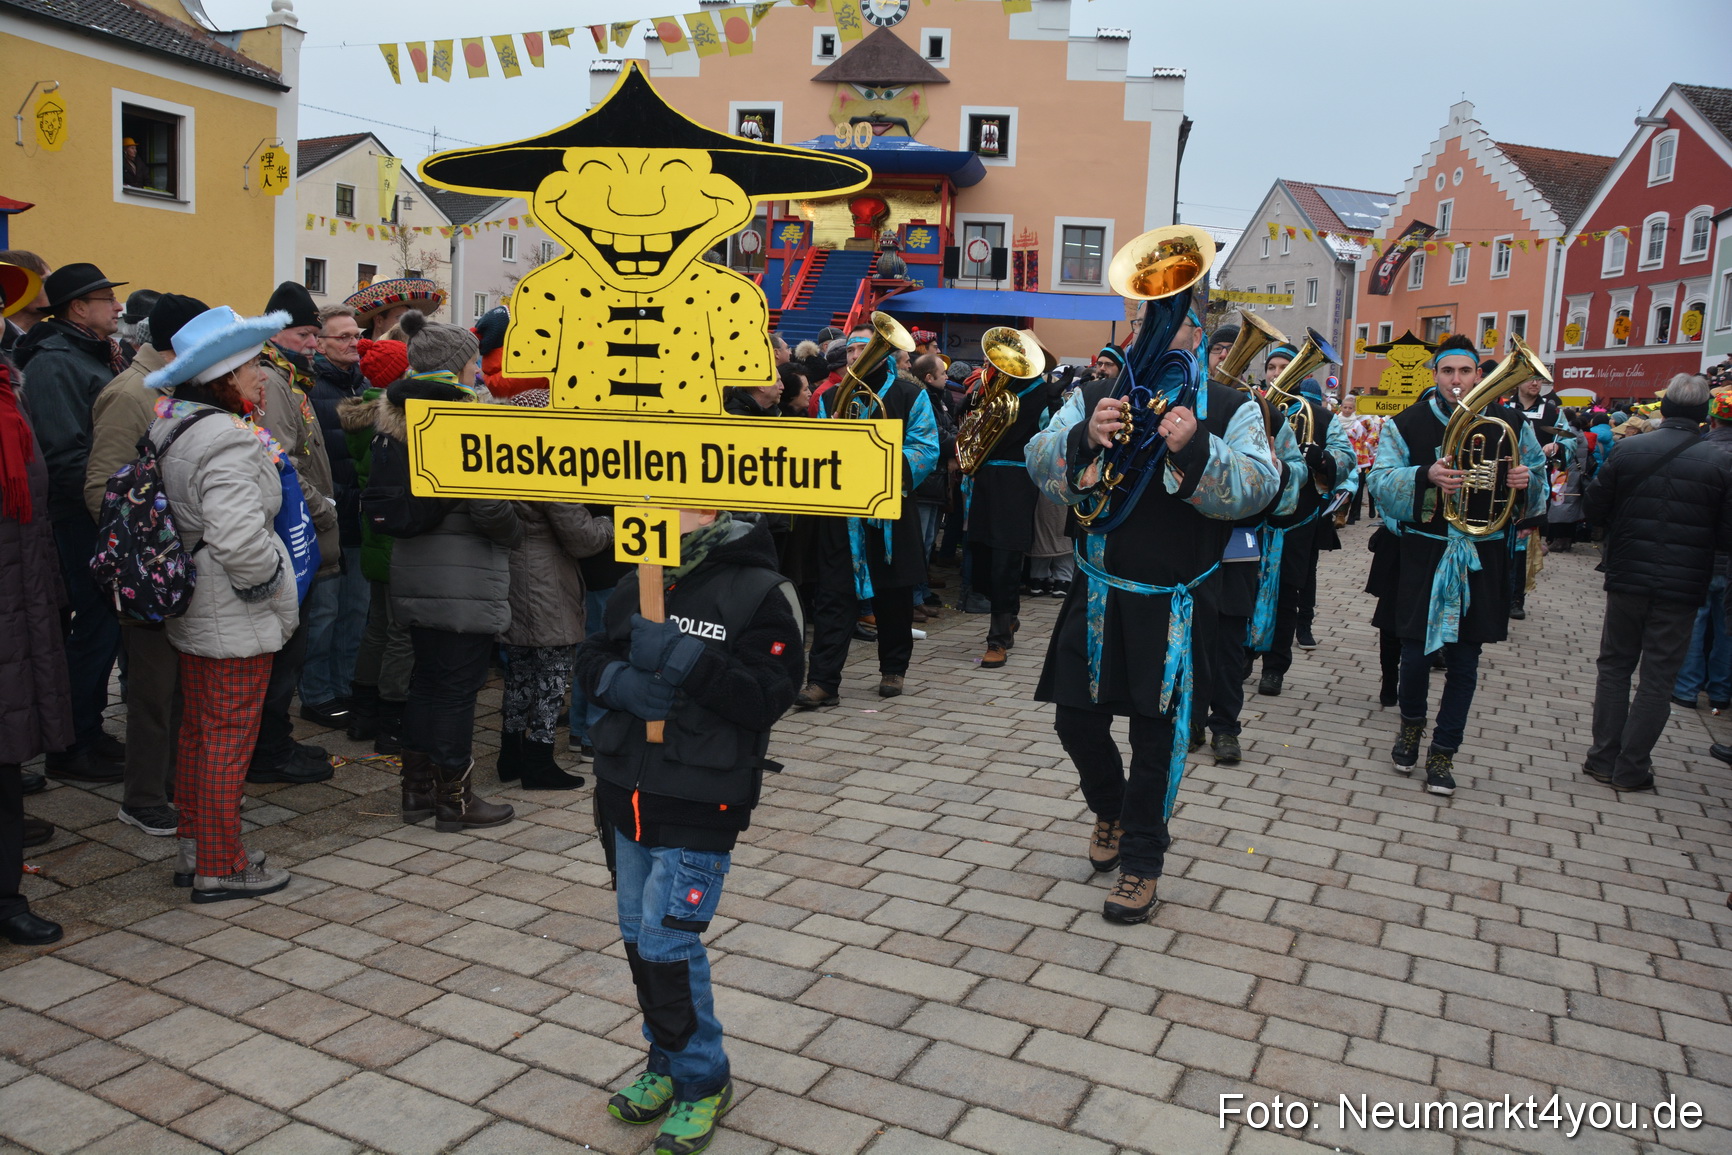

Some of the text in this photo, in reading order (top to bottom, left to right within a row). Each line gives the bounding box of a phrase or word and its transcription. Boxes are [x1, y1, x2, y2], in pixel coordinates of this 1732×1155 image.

[834, 122, 872, 148] 90
[1329, 329, 1339, 376] SCHCK
[1376, 401, 1401, 410] Kaiser
[461, 434, 842, 490] Blaskapellen Dietfurt
[621, 517, 668, 559] 31
